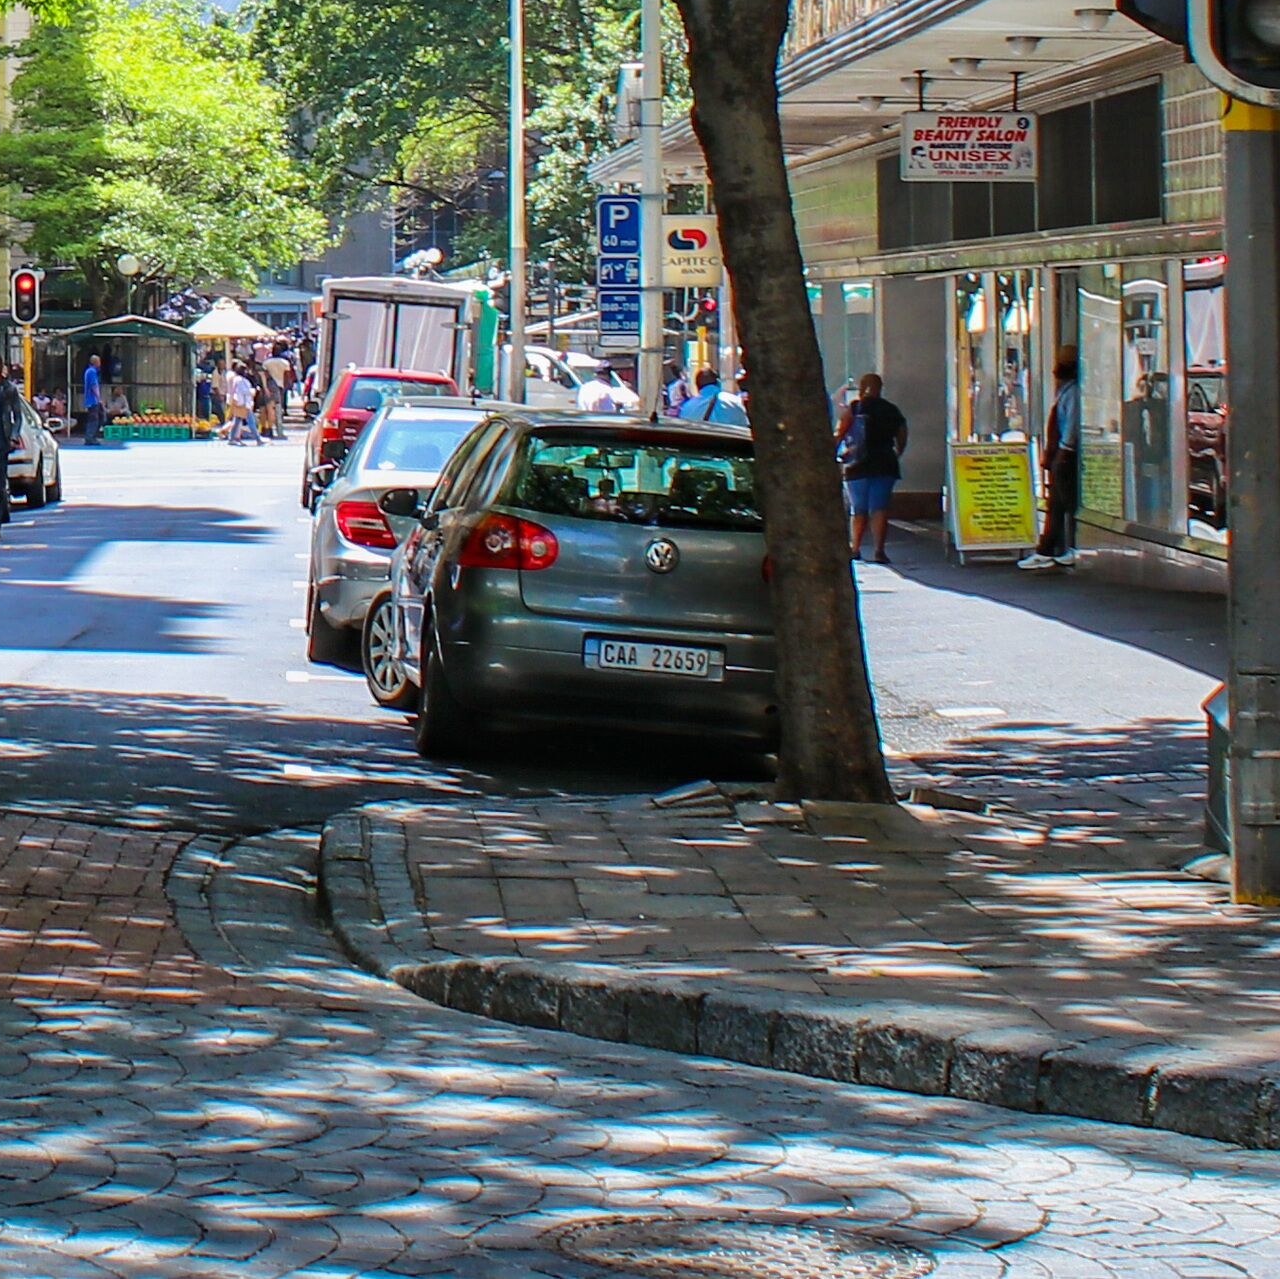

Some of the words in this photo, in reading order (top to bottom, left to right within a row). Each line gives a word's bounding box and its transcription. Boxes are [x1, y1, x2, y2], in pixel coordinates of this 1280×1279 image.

[937, 116, 1004, 128] FRIENDLY
[913, 129, 973, 141] BEAUTY
[976, 130, 1027, 141] SALON
[928, 150, 1013, 162] UNISEX
[609, 204, 630, 229] P
[602, 235, 619, 247] 60
[603, 643, 638, 666] CAA
[651, 647, 707, 672] 22659
